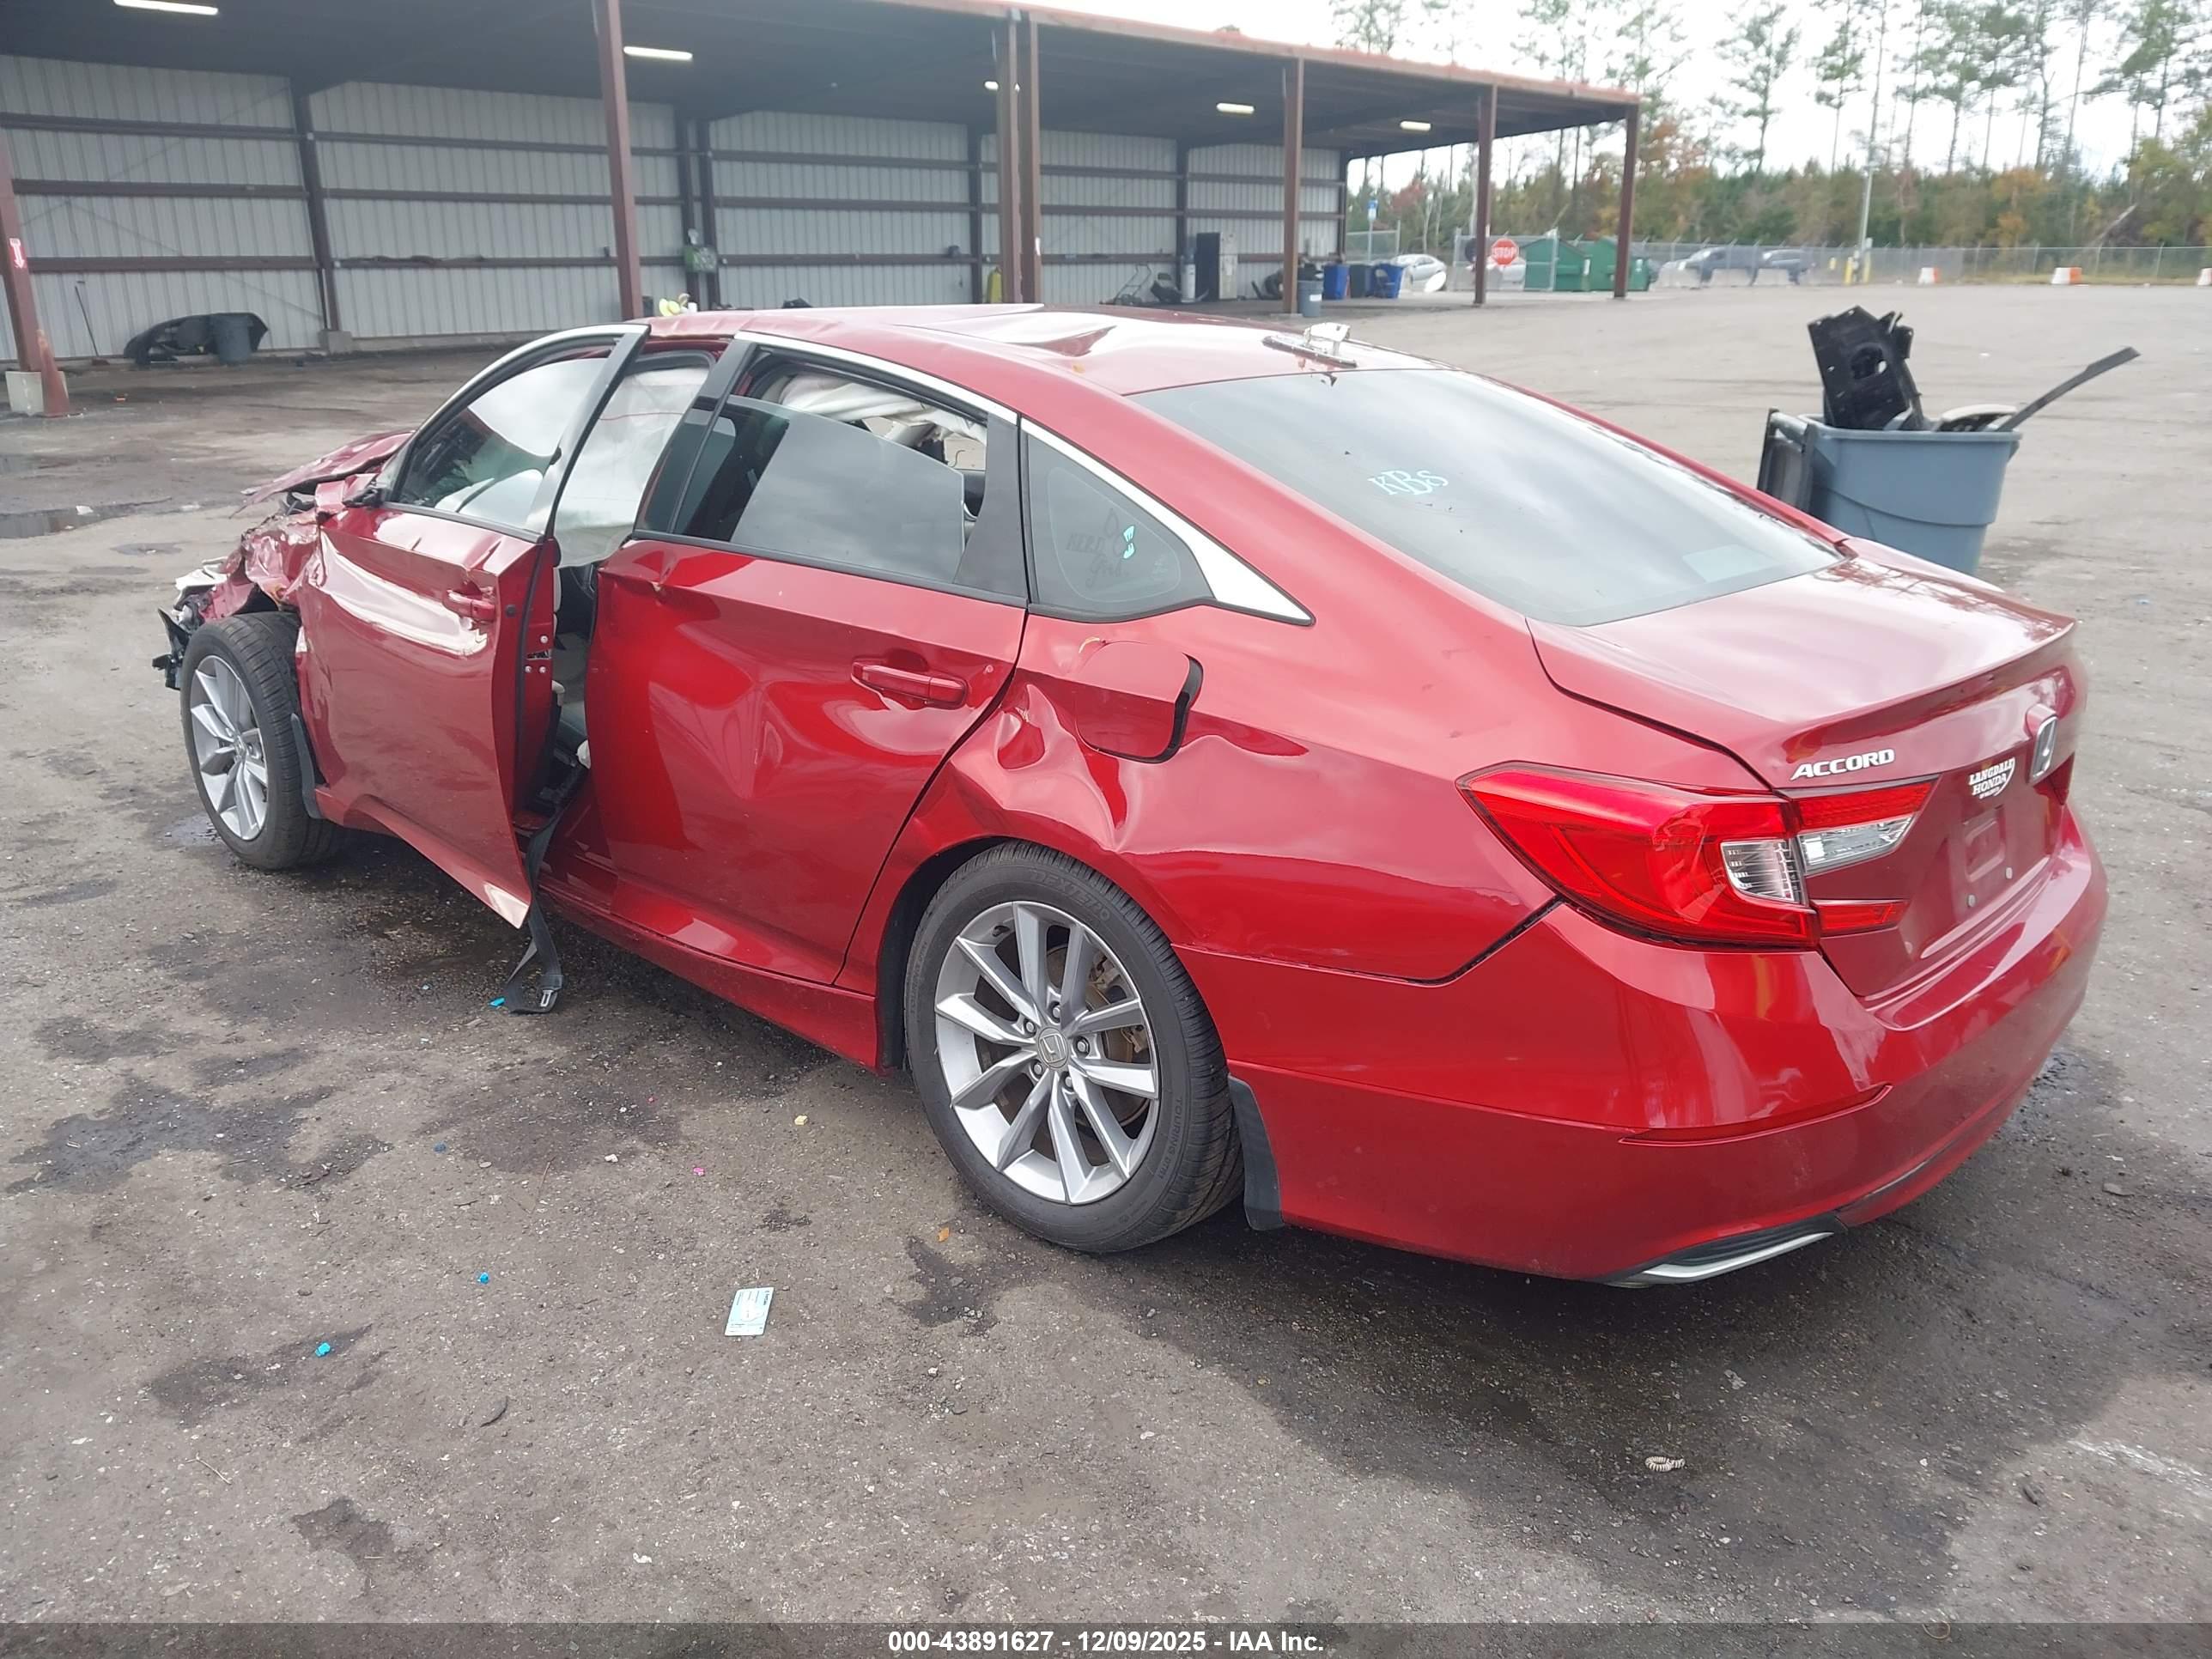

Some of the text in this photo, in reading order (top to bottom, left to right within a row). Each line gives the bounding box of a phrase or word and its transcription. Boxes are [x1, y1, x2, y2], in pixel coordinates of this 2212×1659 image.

[1493, 247, 1517, 258] STOP
[1790, 748, 1895, 781] ACCORD
[1968, 757, 2014, 785] LANGDALE
[1972, 773, 2008, 795] HONDA
[1167, 1098, 1183, 1155] TOURING
